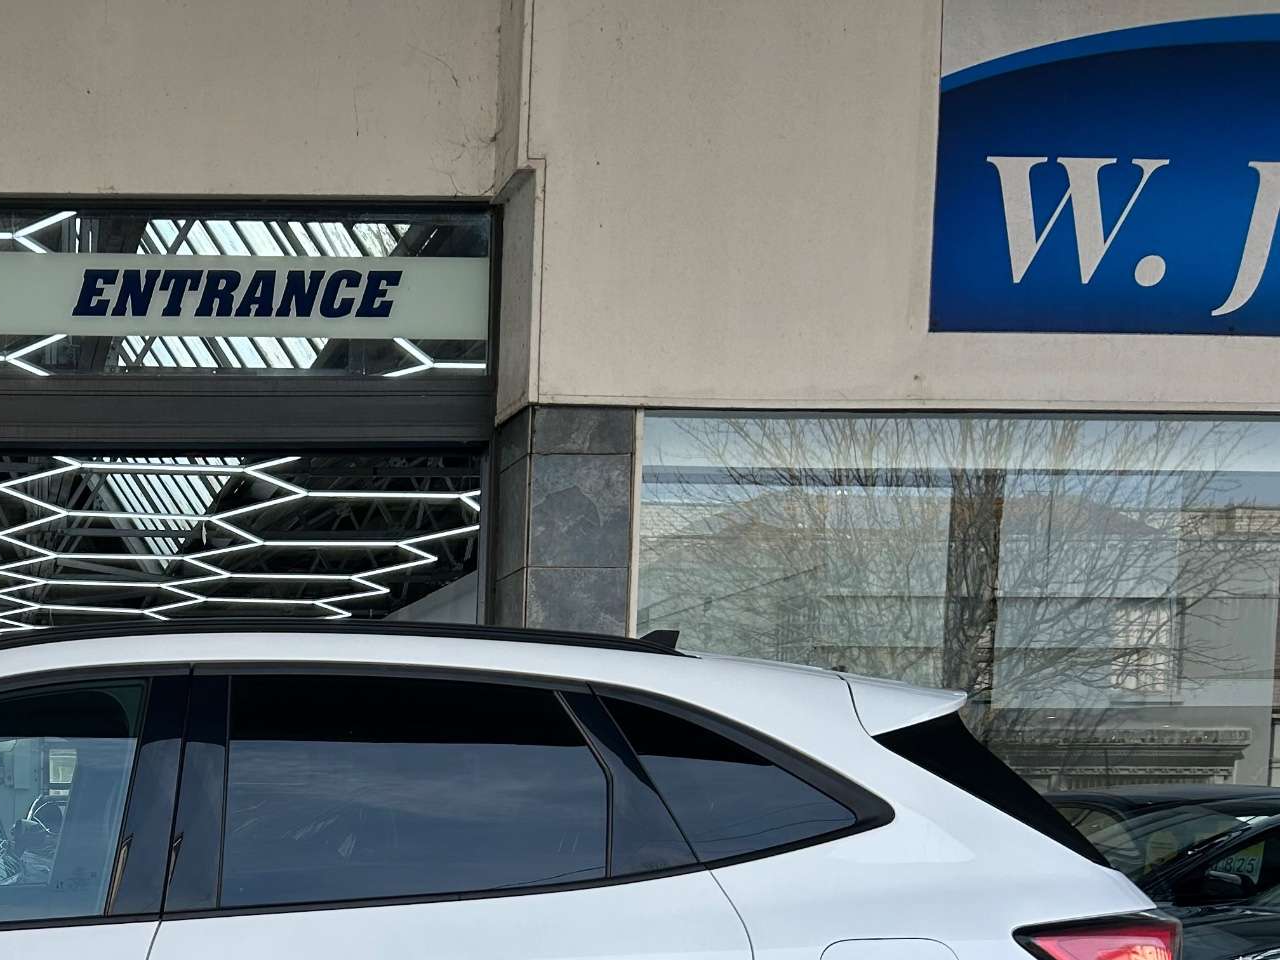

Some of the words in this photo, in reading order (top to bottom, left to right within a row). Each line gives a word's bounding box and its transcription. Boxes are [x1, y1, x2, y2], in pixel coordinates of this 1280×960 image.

[986, 156, 1170, 287] W.
[1211, 161, 1280, 316] J
[72, 269, 402, 319] ENTRANCE
